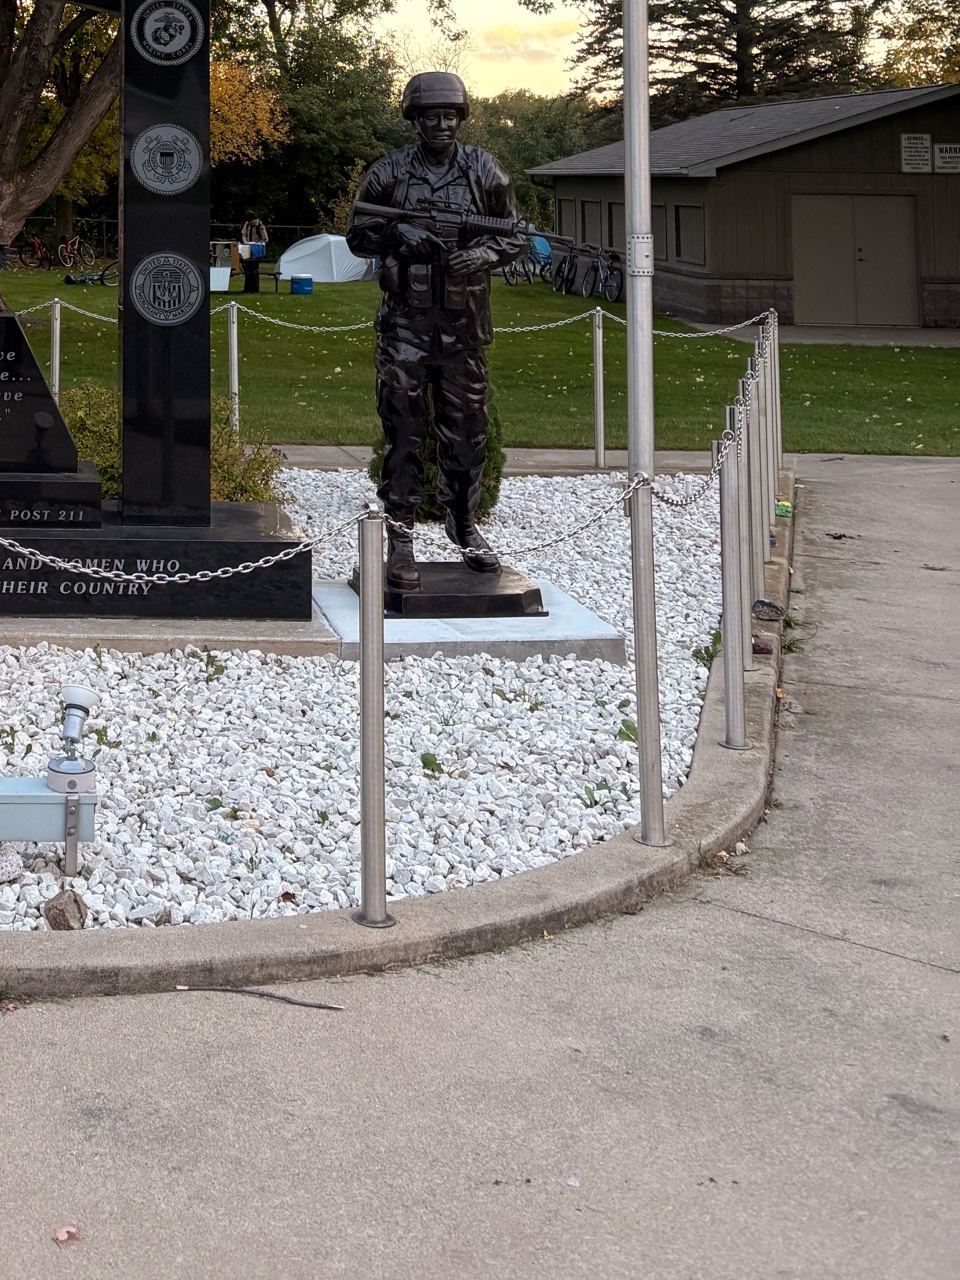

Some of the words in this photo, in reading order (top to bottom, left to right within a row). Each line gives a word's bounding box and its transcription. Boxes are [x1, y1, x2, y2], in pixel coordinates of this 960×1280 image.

[142, 1, 165, 19] UNITED
[172, 2, 193, 21] STATES
[141, 39, 166, 58] MARINE
[140, 258, 162, 276] UNITED
[172, 258, 192, 276] STATES
[137, 291, 162, 318] MERCHANT
[171, 300, 194, 318] MARINE
[9, 509, 51, 521] POST
[58, 510, 85, 521] 211
[1, 557, 43, 570] AND
[136, 559, 180, 572] WHO
[59, 581, 153, 595] COUNTRY
